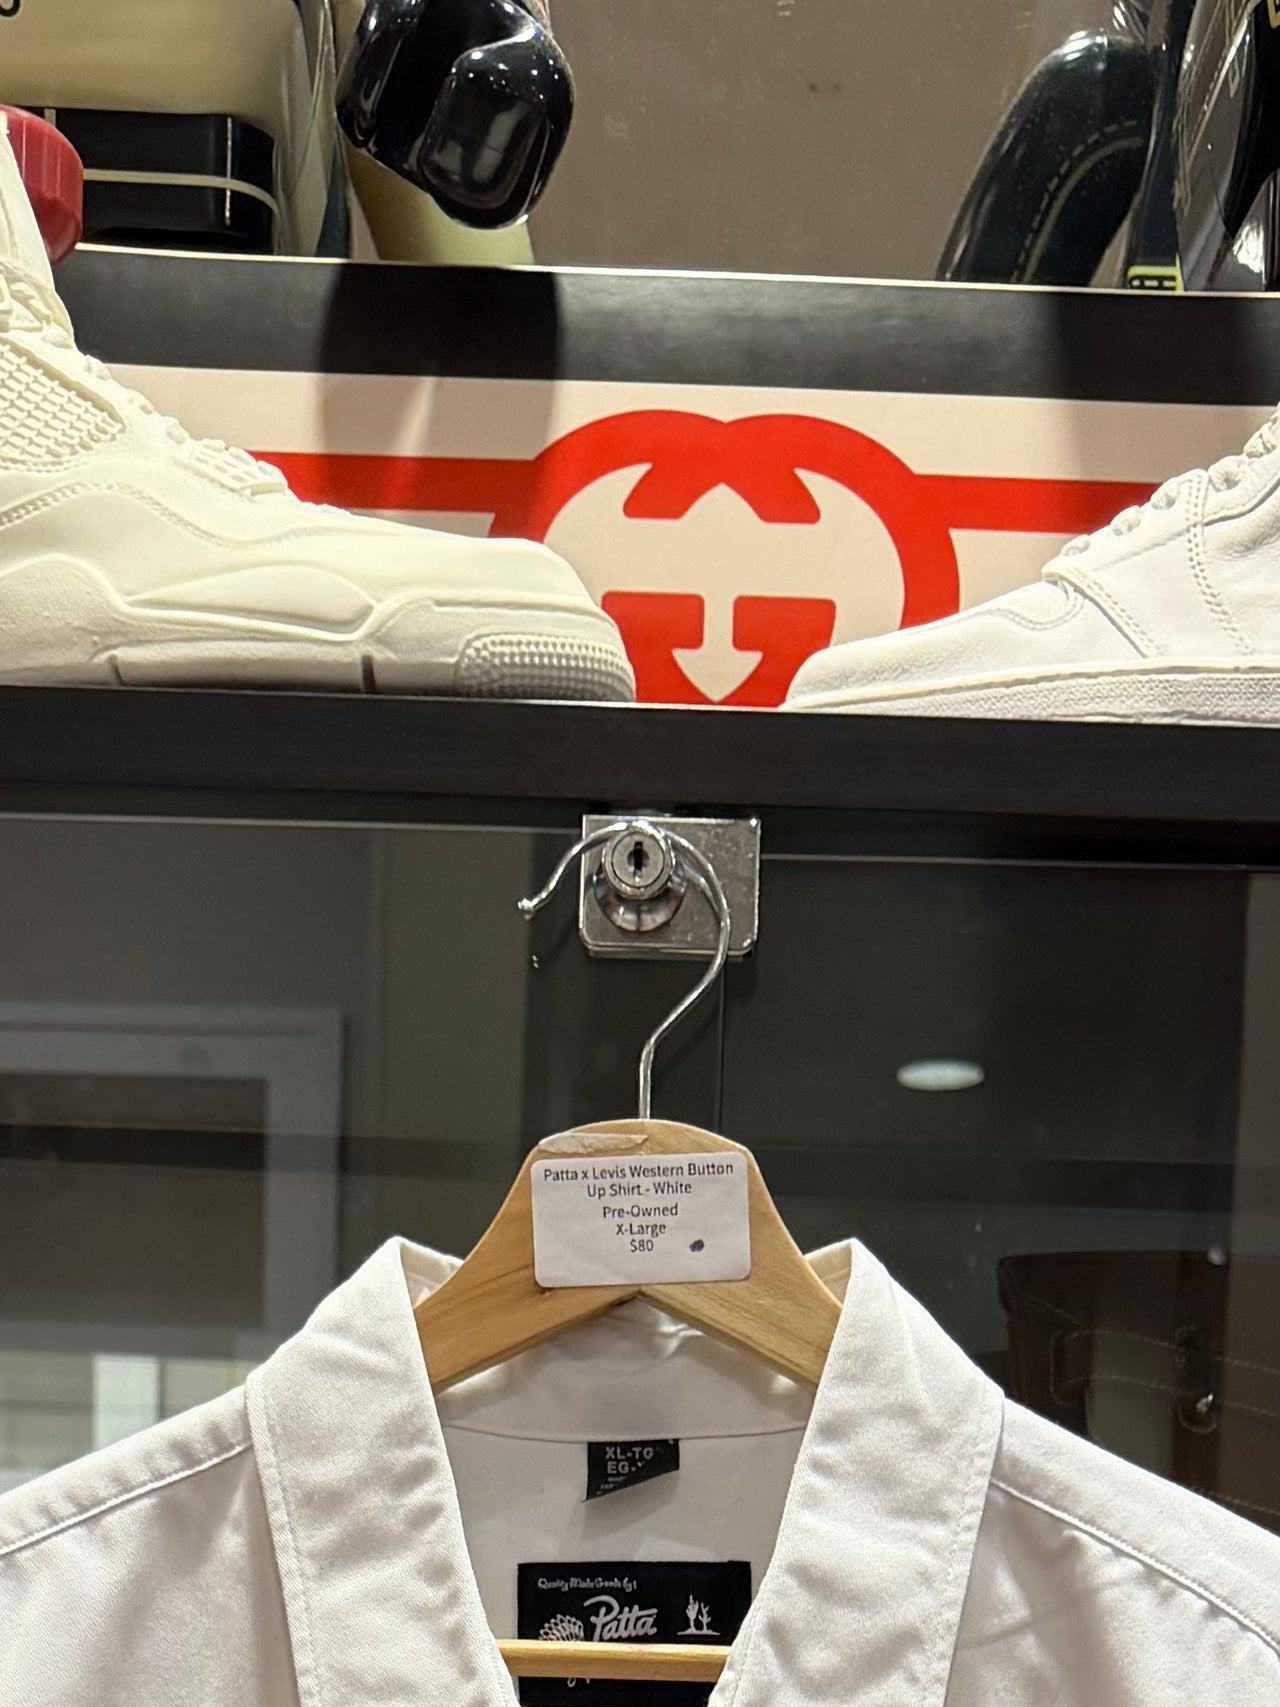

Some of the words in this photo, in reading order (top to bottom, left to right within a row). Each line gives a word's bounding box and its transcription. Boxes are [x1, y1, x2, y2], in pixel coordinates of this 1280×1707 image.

[543, 1168, 579, 1182] Patta
[581, 1171, 589, 1180] x
[592, 1164, 627, 1180] Levis
[629, 1164, 684, 1179] Western
[687, 1162, 734, 1176] Button
[587, 1183, 606, 1200] Up
[609, 1182, 643, 1197] Shirt
[653, 1181, 692, 1195] White
[602, 1202, 679, 1219] Pre-Owned
[616, 1222, 667, 1238] X-Large
[629, 1239, 655, 1253] $80
[581, 1593, 659, 1643] Patta
